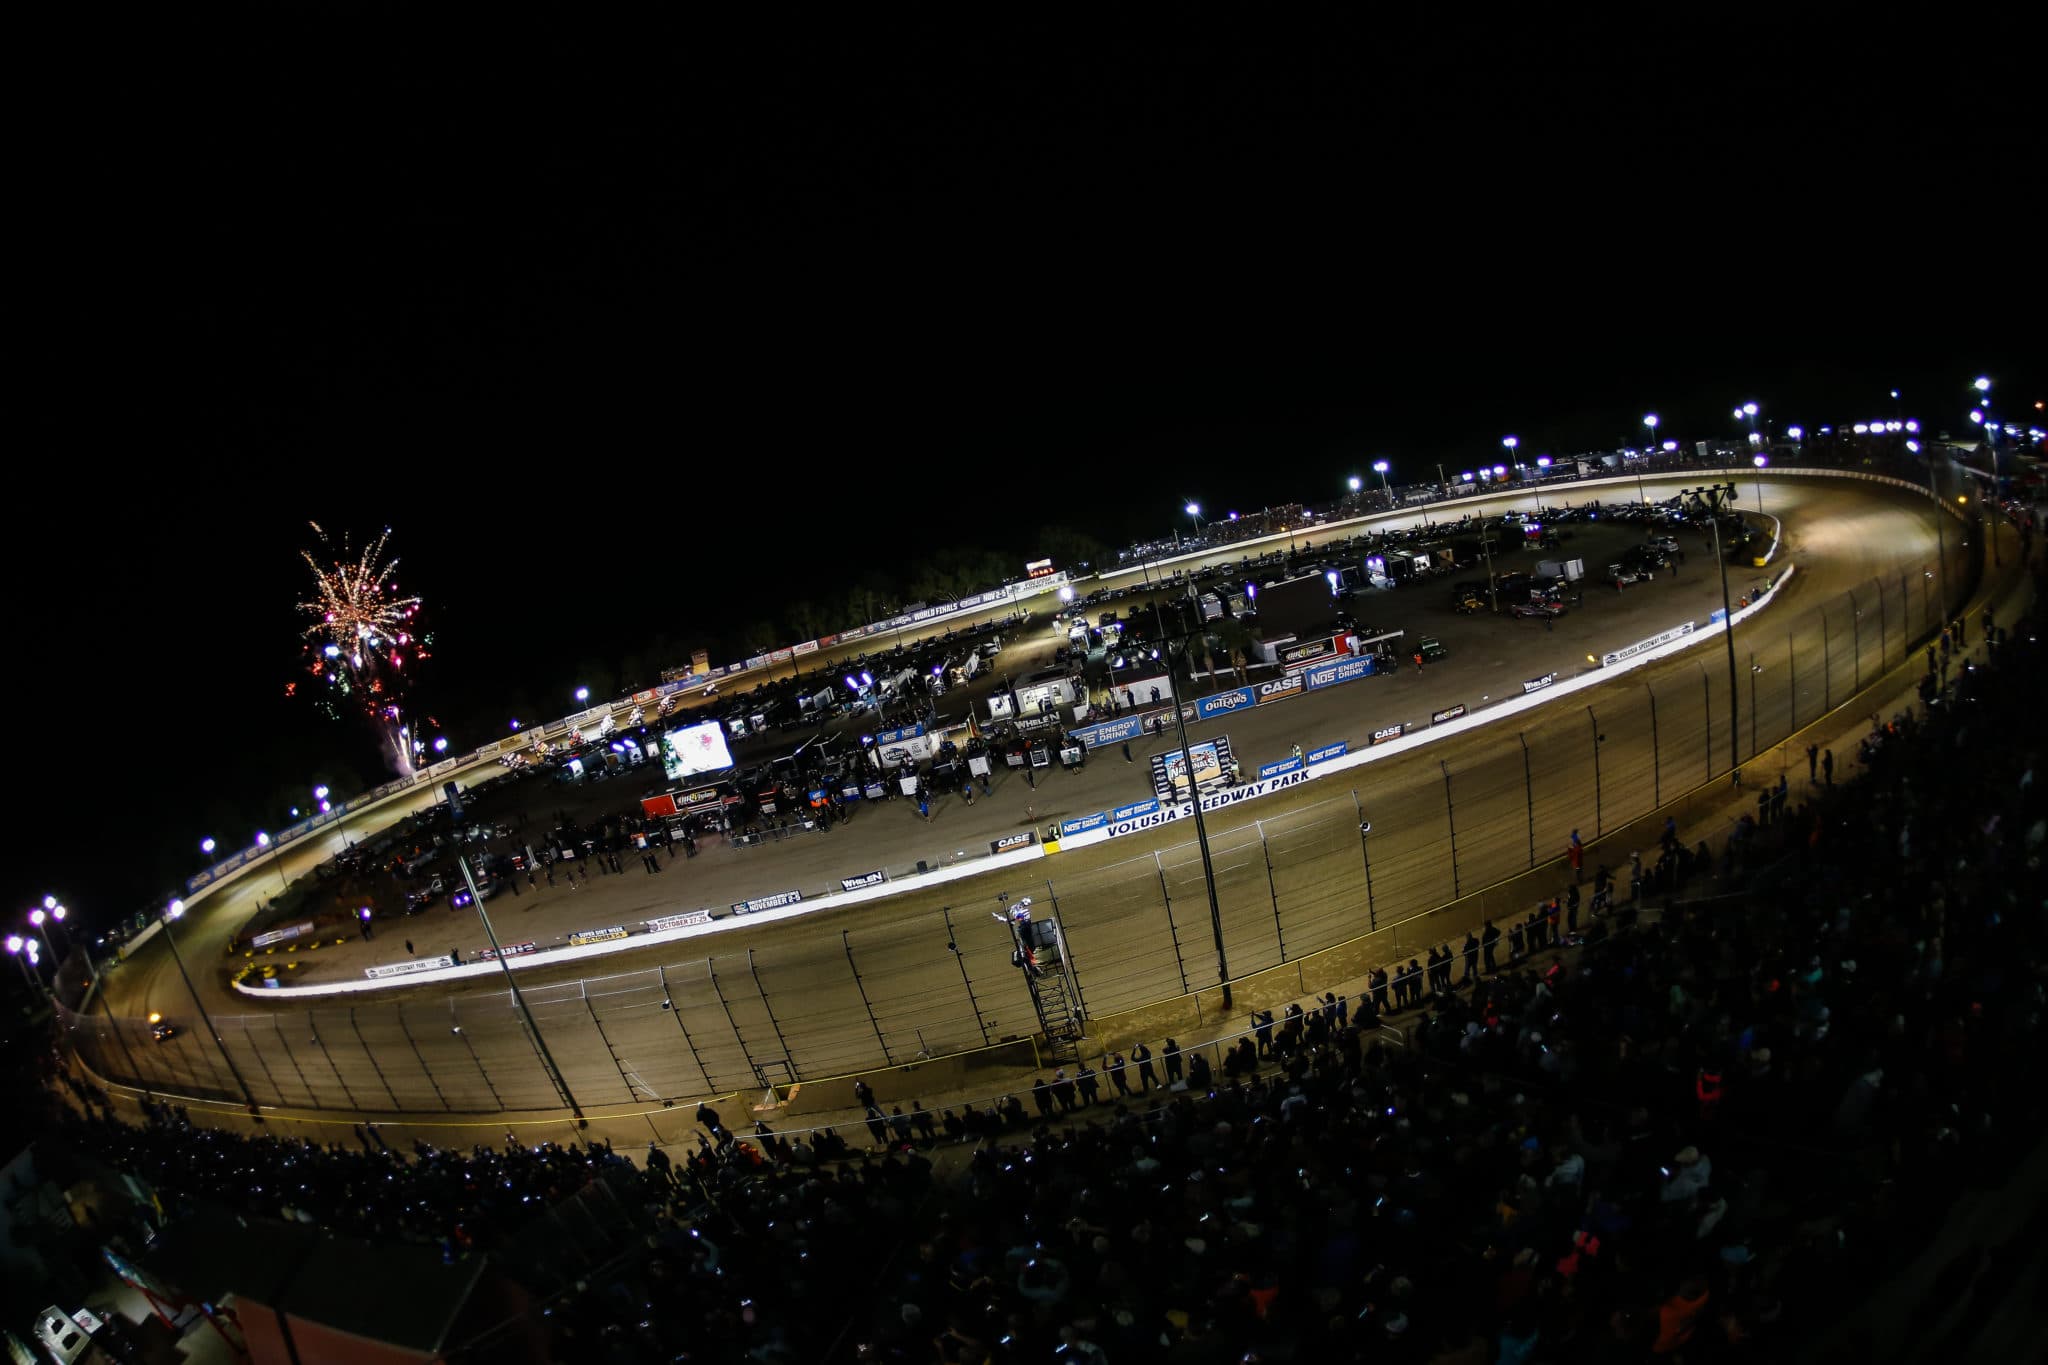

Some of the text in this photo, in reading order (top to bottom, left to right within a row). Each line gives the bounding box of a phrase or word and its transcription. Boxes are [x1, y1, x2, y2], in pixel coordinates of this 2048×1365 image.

[914, 608, 936, 621] WORLD
[936, 603, 958, 616] FINALS
[1338, 659, 1371, 673] ENERGY
[1338, 668, 1364, 679] DRINK
[1311, 668, 1337, 686] NOS
[1261, 676, 1302, 695] CASE
[1014, 711, 1060, 730] WHELEN
[1099, 720, 1136, 735] ENERGY
[1099, 729, 1129, 741] DRINK
[1375, 726, 1401, 739] CASE
[1107, 769, 1311, 837] VOLUSIA SEEDWAY PARK
[998, 833, 1030, 848] CASE
[841, 871, 882, 888] WHELEN
[749, 897, 787, 912] NOVEMBER
[659, 919, 688, 929] OCTOBER
